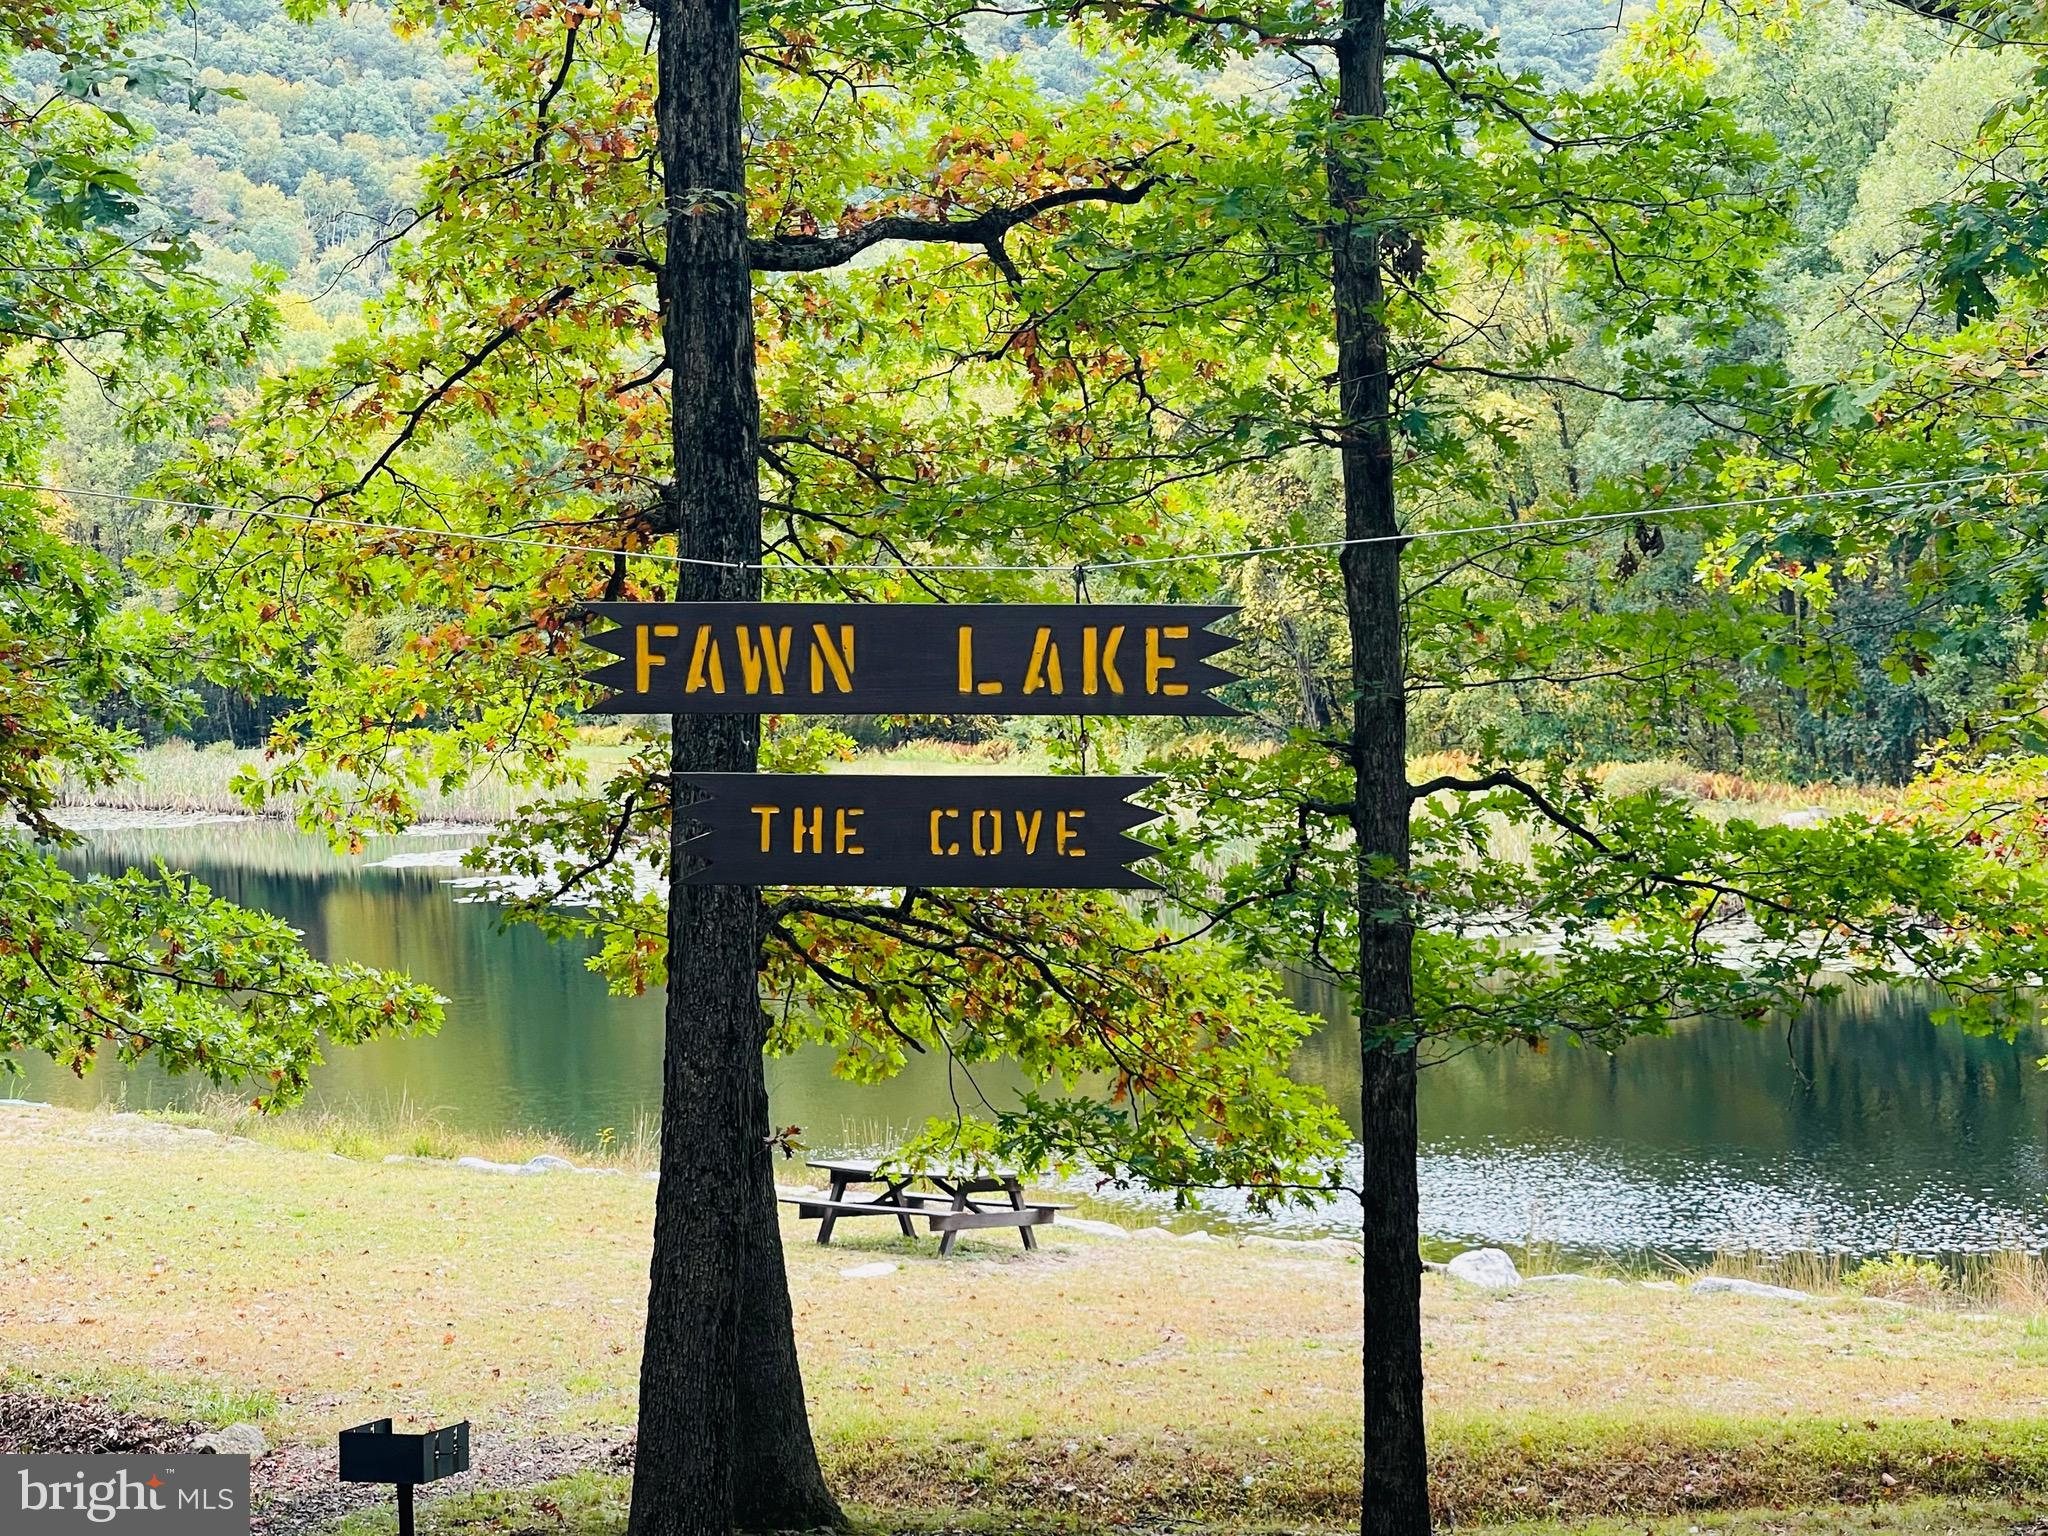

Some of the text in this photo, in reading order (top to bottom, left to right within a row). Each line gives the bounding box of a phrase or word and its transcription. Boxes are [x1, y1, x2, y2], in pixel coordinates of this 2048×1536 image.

[635, 623, 1189, 696] FAWN LAKE
[751, 806, 1086, 857] THE COVE
